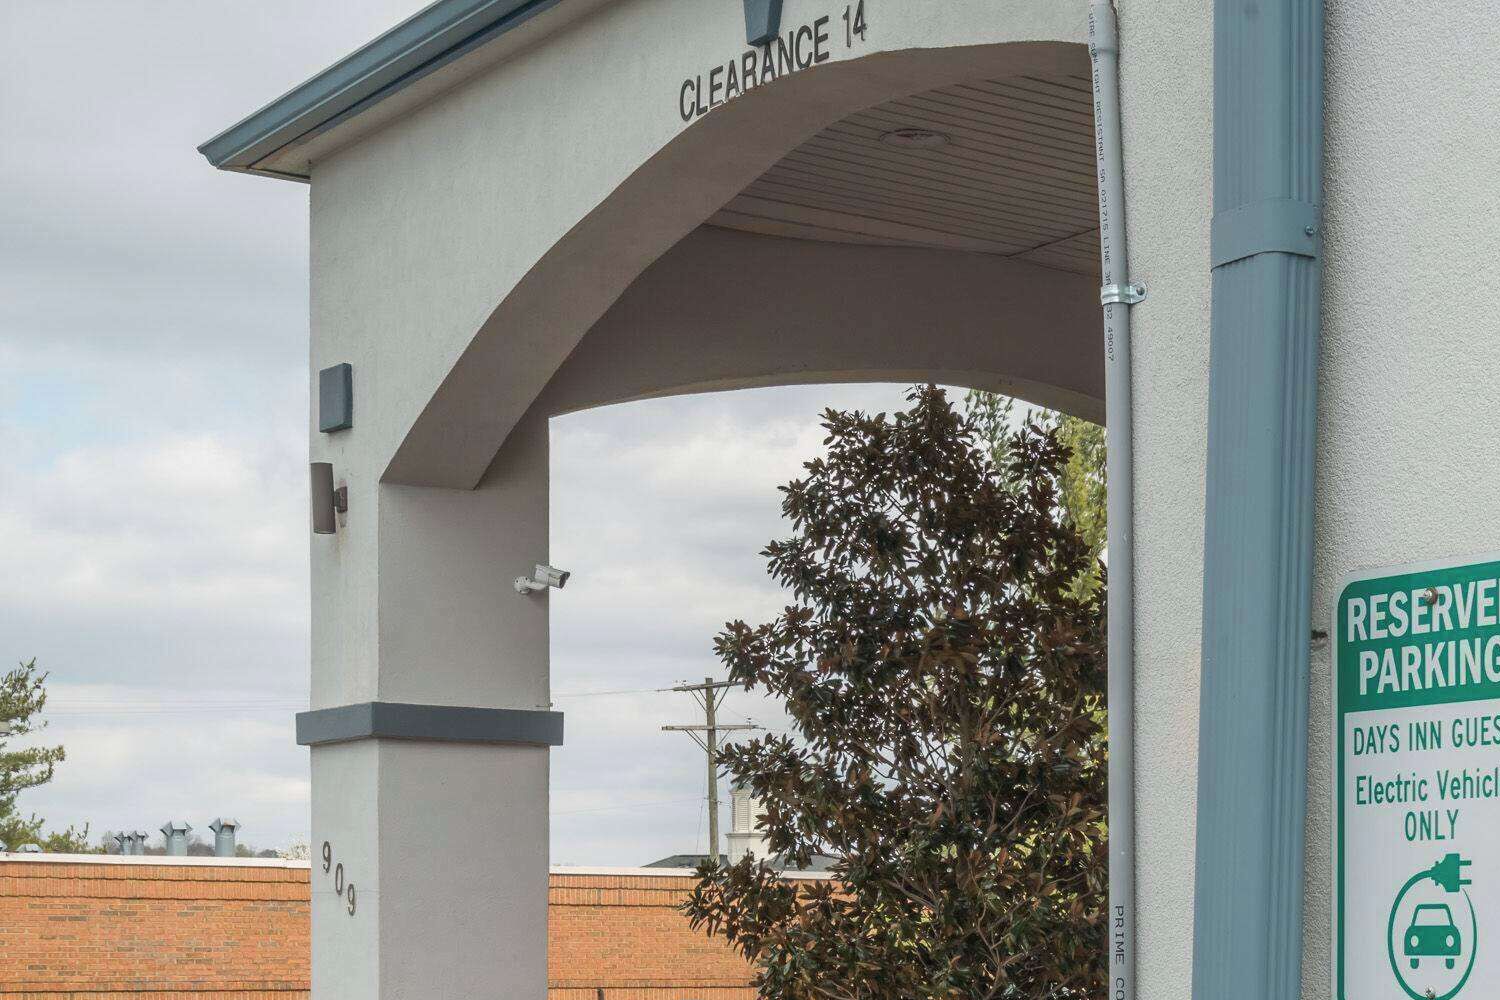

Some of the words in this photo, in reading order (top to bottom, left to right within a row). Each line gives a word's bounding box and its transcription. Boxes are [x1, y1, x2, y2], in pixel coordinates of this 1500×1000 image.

[679, 15, 830, 122] CLEARANCE
[842, 0, 868, 48] 14
[1353, 724, 1400, 756] DAYS
[1409, 720, 1442, 751] INN
[1356, 771, 1428, 805] Electric
[1404, 809, 1459, 842] ONLY
[322, 841, 356, 917] 909
[1114, 905, 1125, 965] PRIME
